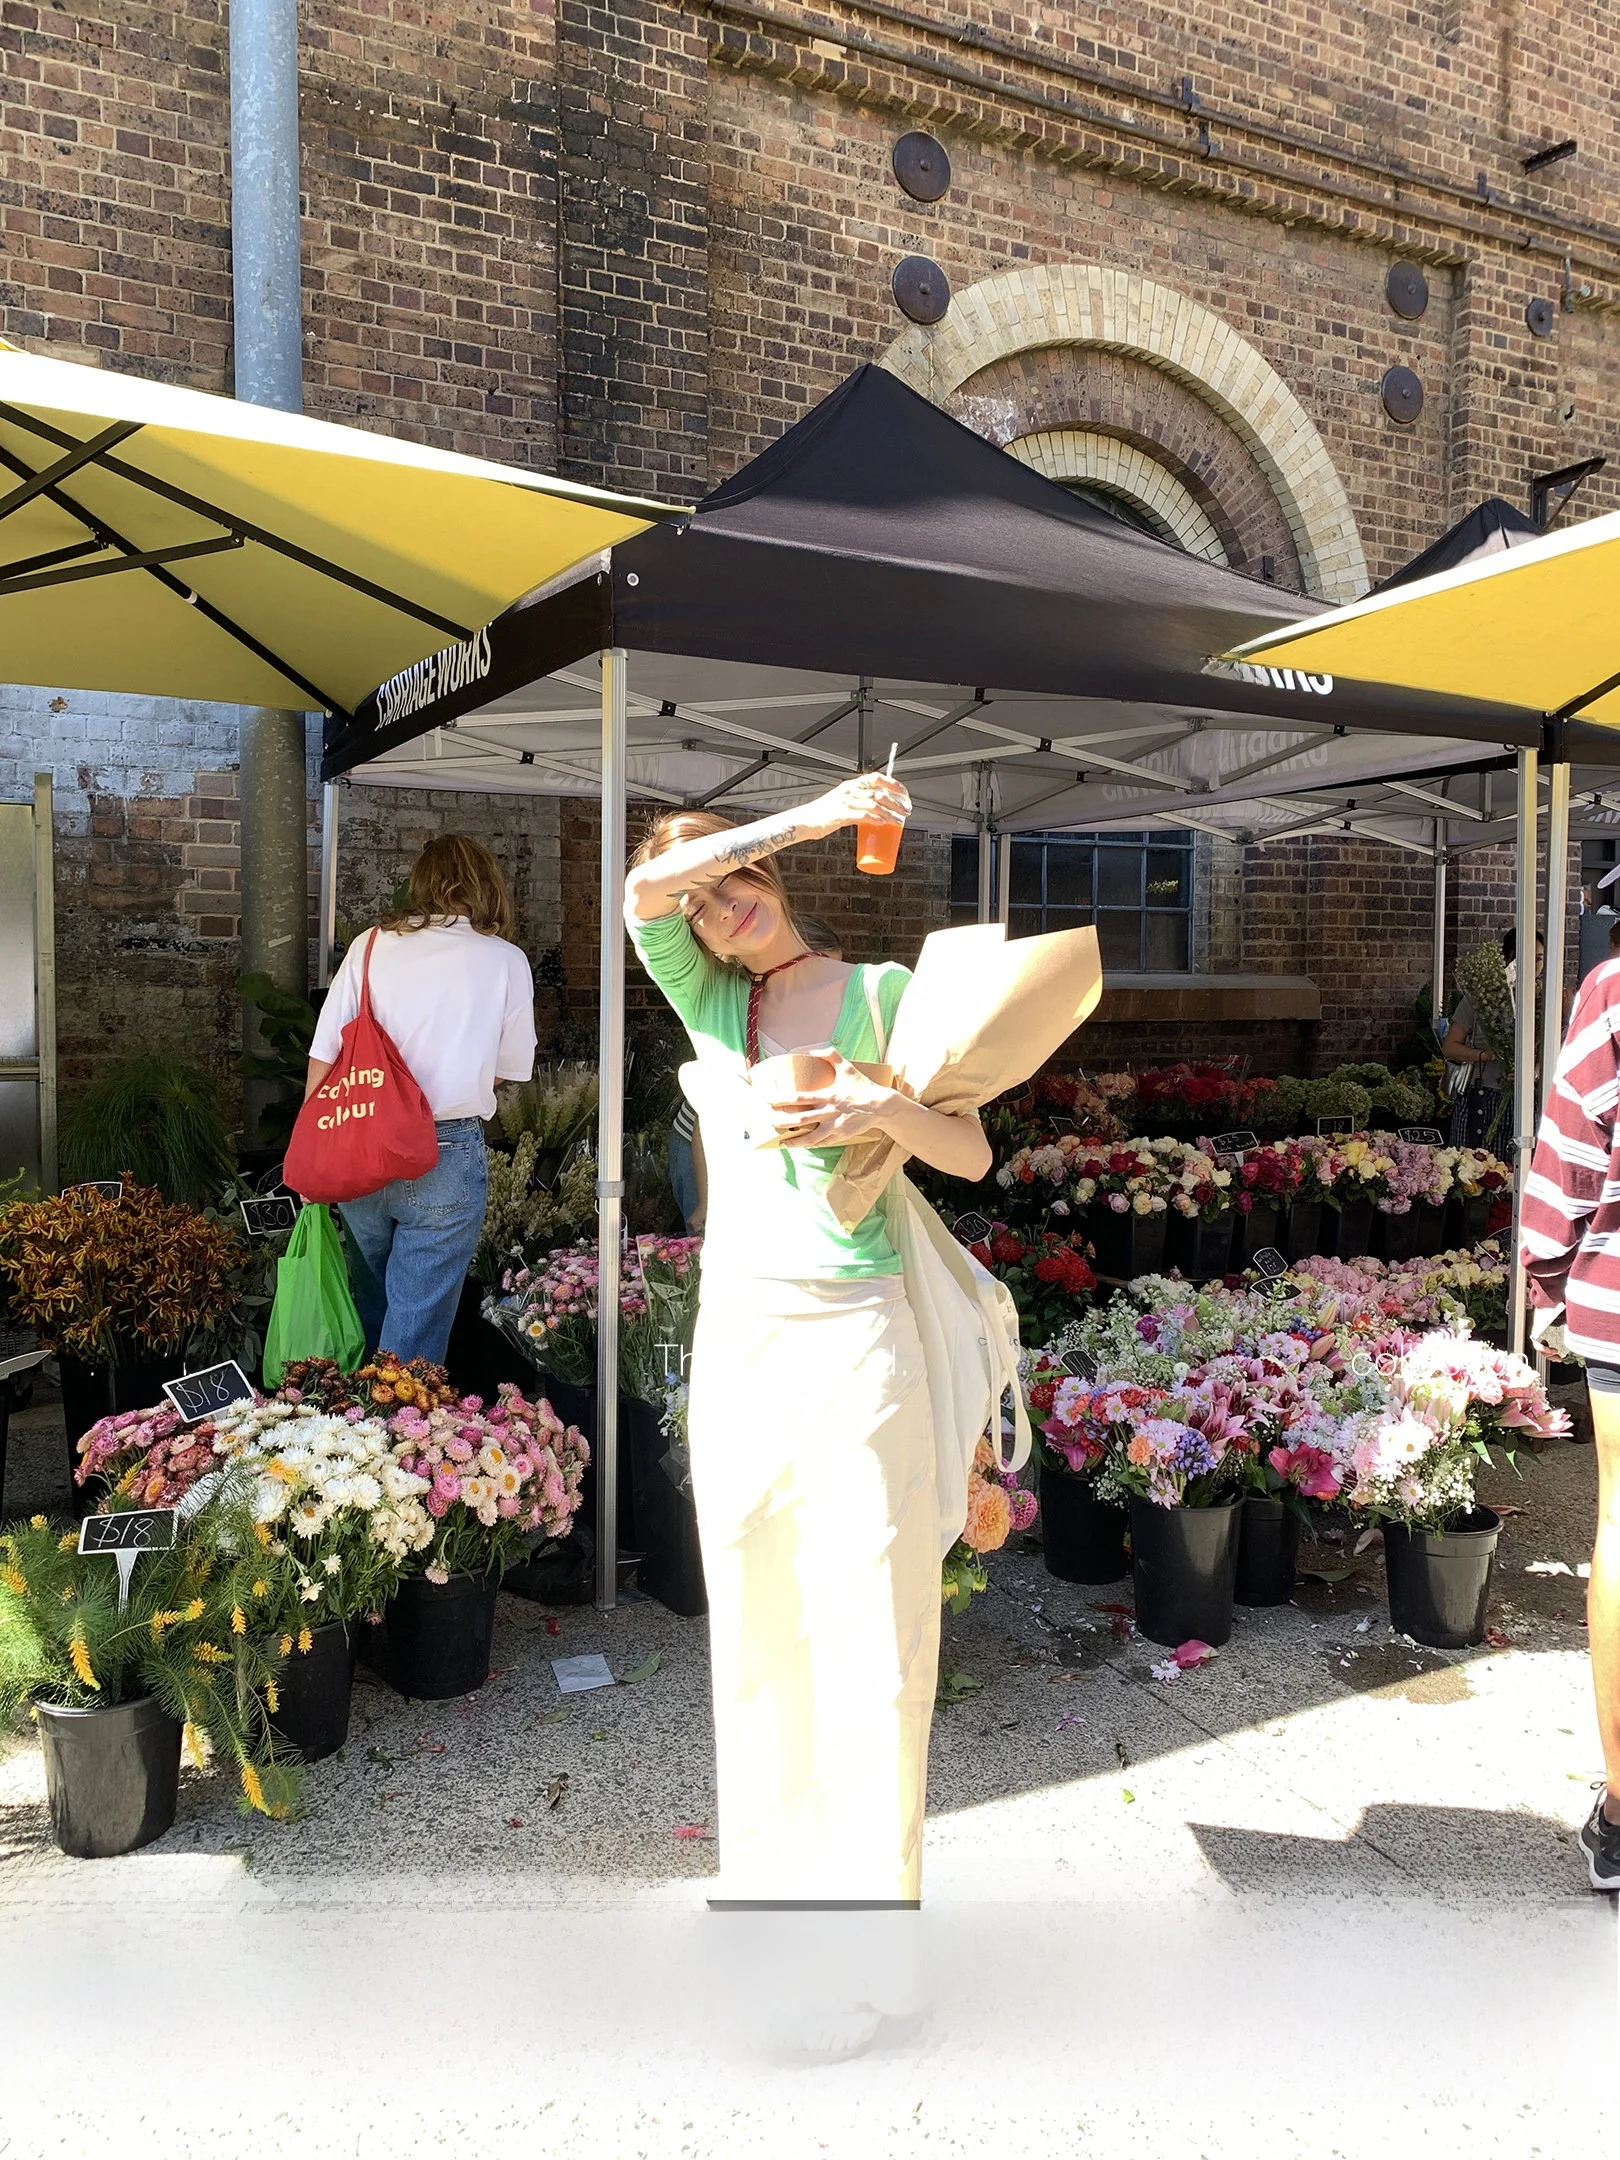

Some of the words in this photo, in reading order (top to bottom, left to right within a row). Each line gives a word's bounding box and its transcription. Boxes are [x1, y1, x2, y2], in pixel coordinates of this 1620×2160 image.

[1404, 1129, 1436, 1143] $25
[249, 1202, 290, 1229] $30
[175, 1369, 230, 1414] $18
[90, 1516, 155, 1548] $18
